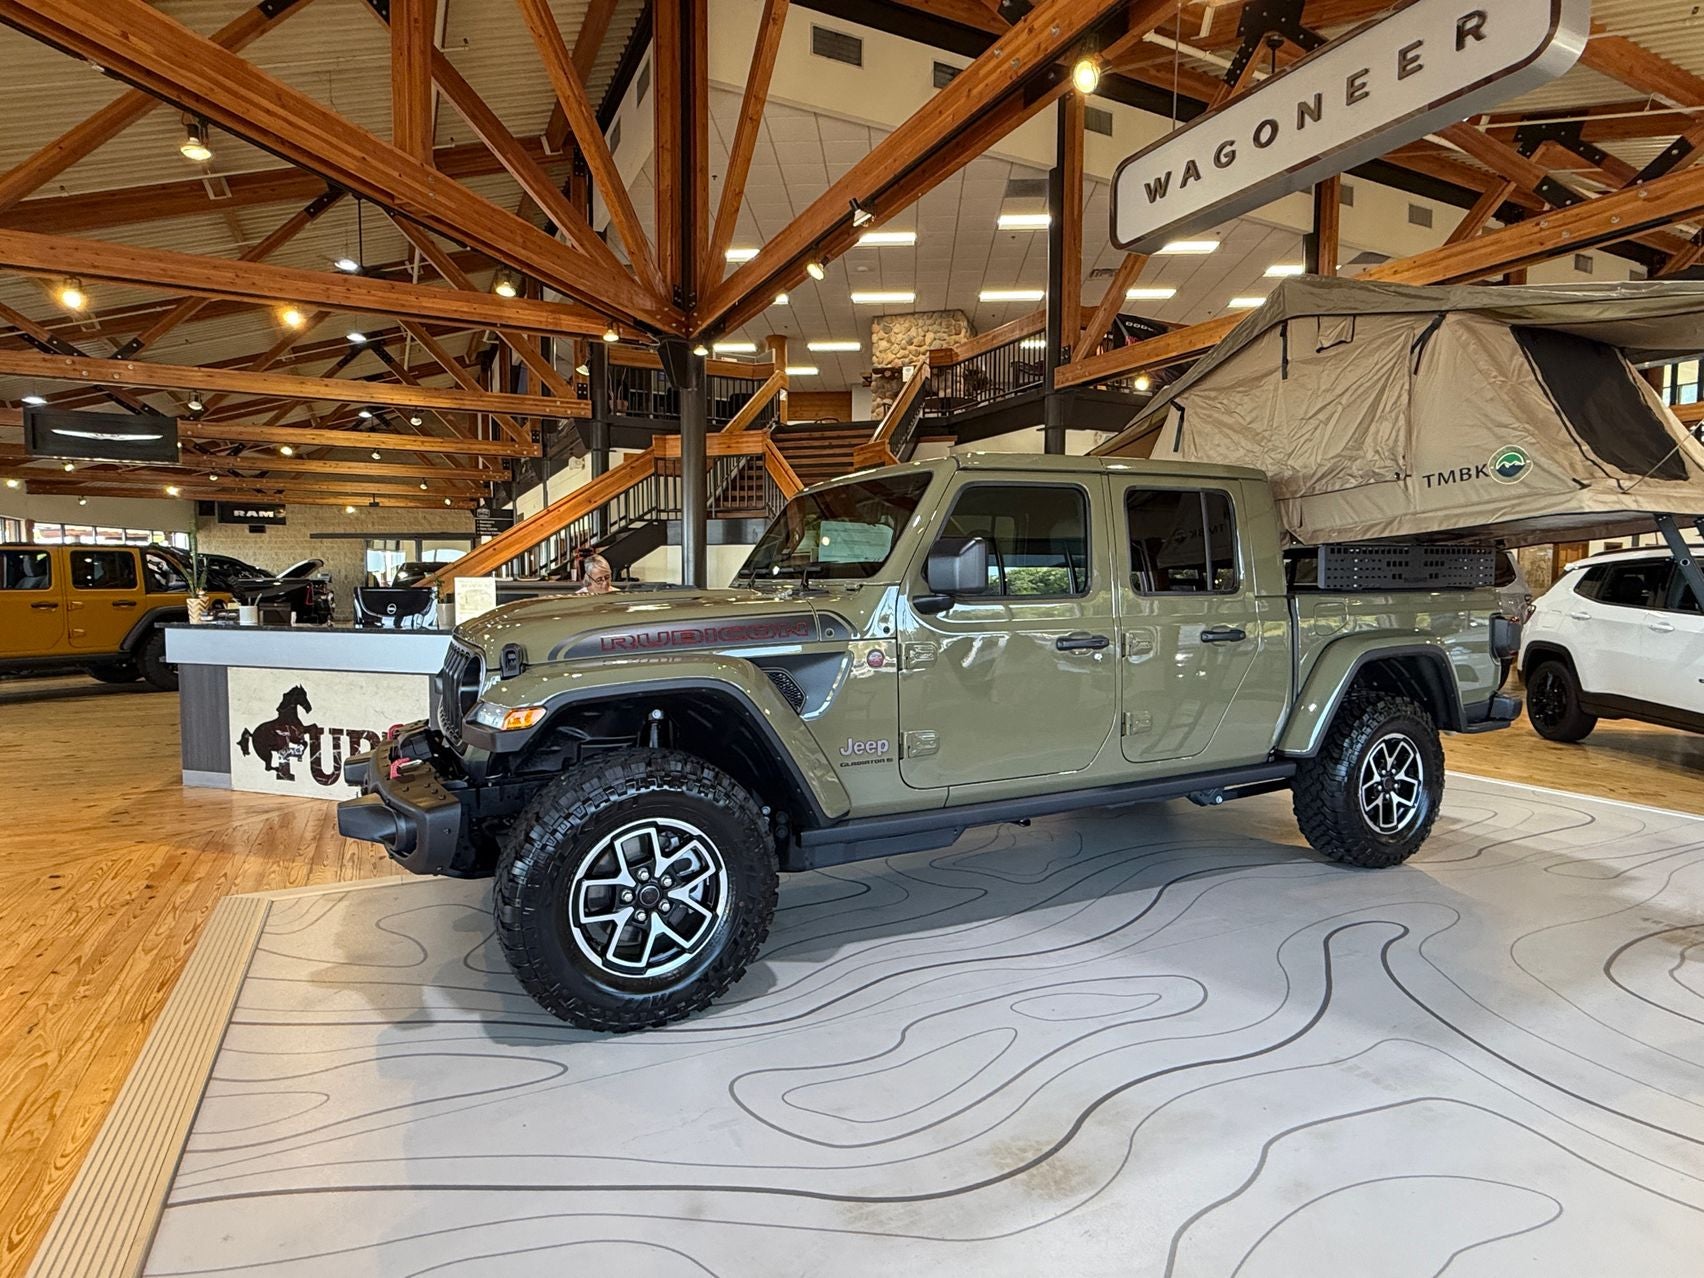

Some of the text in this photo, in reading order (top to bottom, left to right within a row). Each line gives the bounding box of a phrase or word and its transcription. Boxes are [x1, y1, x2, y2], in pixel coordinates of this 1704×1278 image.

[1144, 9, 1488, 205] WAGONEER
[1422, 463, 1490, 488] TMBK
[233, 510, 274, 518] RAM
[600, 622, 809, 651] RUBICON
[839, 737, 890, 756] Jeep
[840, 758, 885, 768] GLADIATOR
